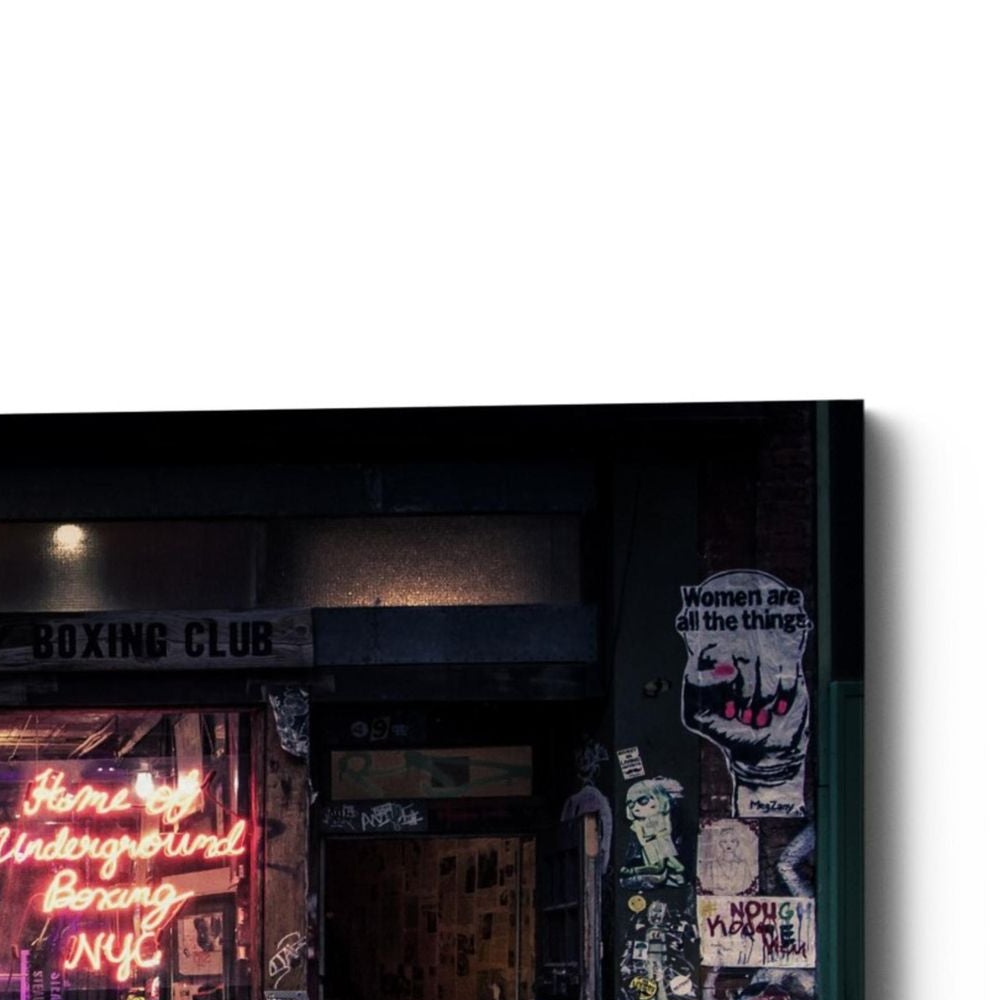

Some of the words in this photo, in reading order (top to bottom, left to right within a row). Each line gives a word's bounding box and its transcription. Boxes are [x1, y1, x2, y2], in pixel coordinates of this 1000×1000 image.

[683, 587, 762, 607] Women
[767, 588, 800, 606] are
[33, 621, 167, 659] BOXING
[184, 619, 273, 658] CLUB
[677, 611, 699, 631] all
[703, 611, 738, 631] the
[23, 768, 133, 816] Home
[145, 769, 202, 825] of
[43, 868, 195, 929] Boxing
[64, 932, 162, 982] NYC
